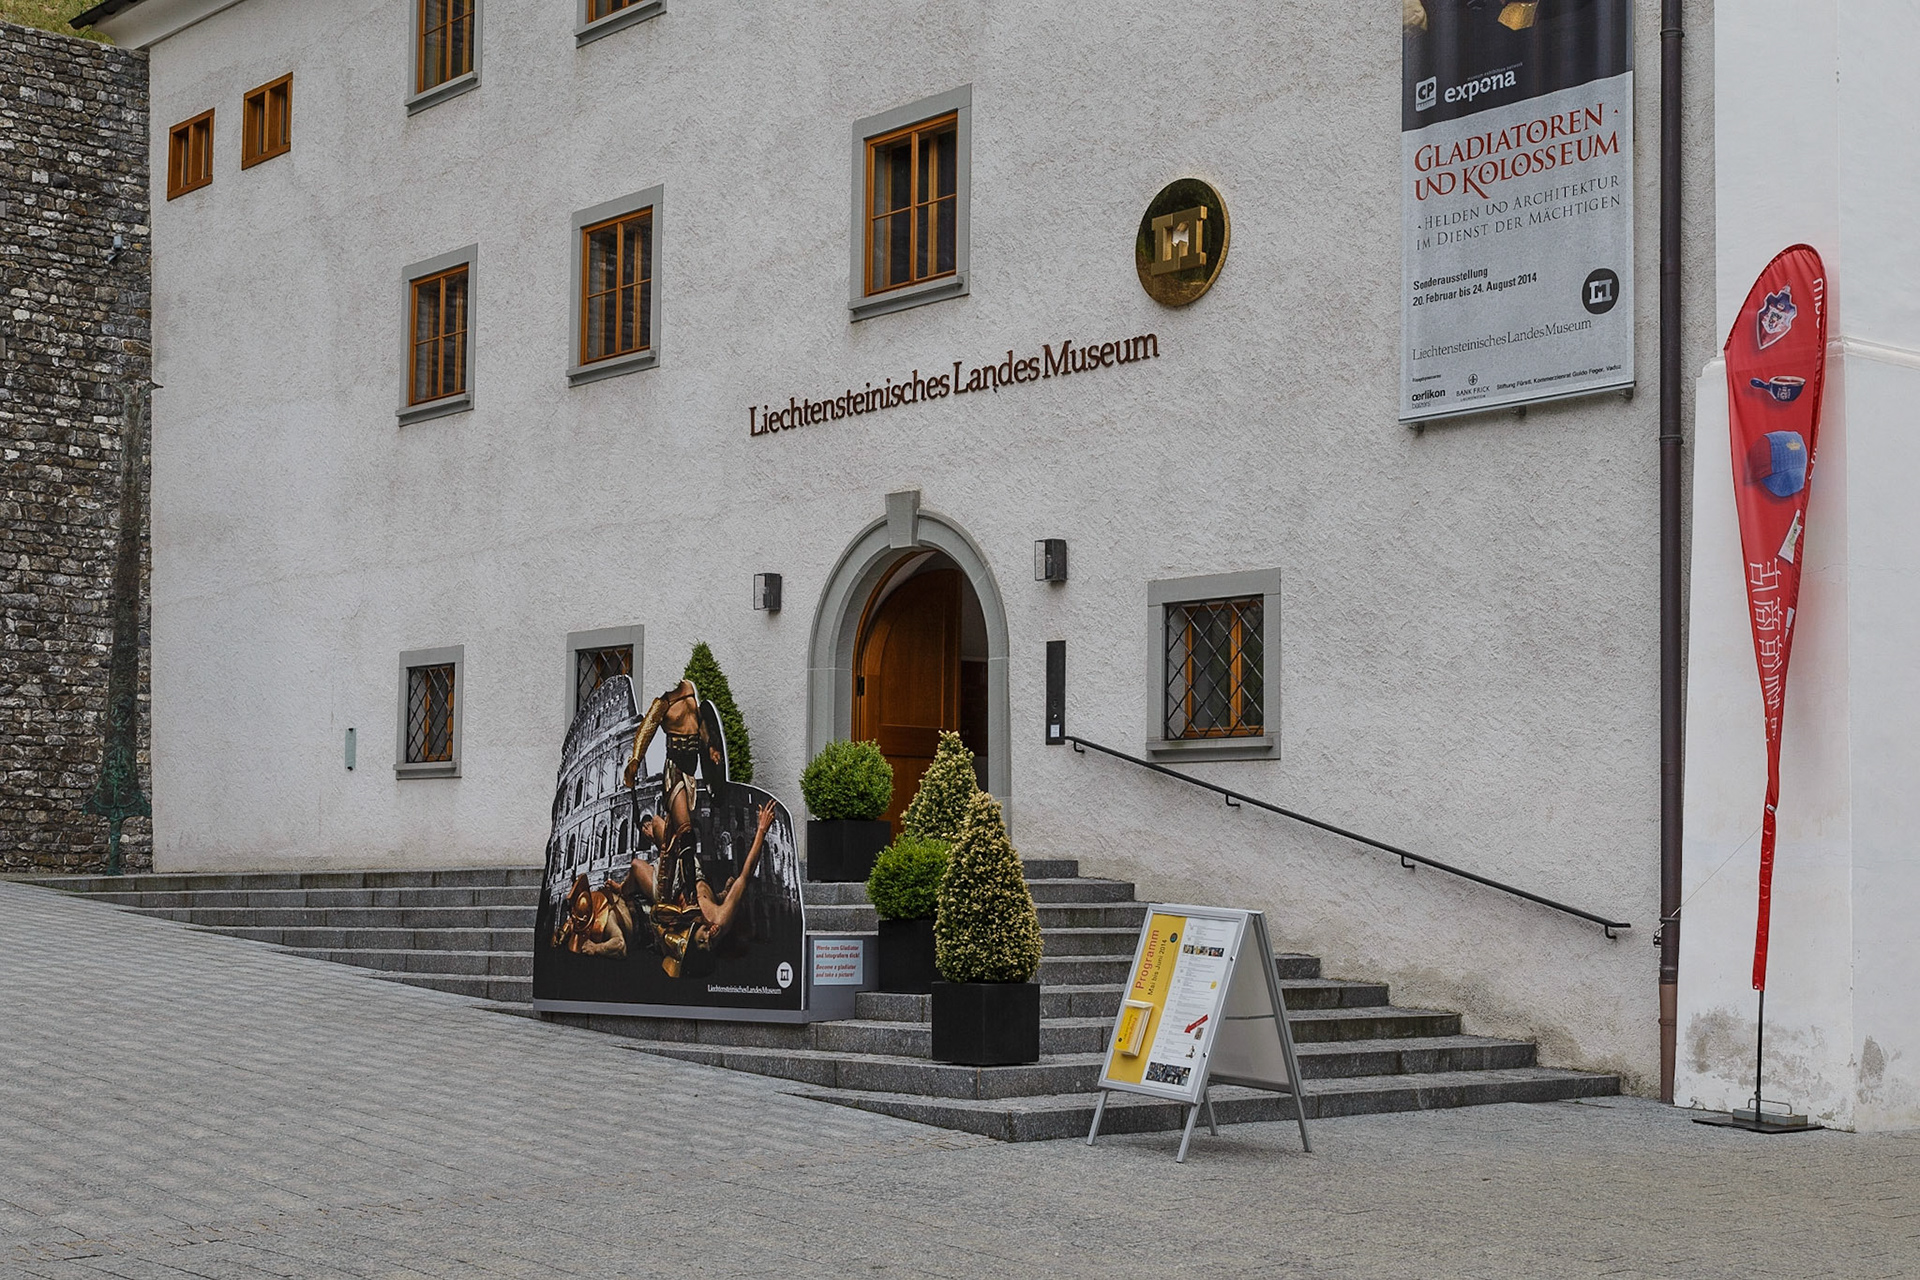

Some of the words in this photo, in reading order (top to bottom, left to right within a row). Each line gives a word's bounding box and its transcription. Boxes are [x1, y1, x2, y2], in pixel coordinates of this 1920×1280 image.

[1444, 70, 1516, 102] expona
[1415, 172, 1456, 201] UND
[1462, 130, 1621, 200] KOLOSSEUM
[1424, 205, 1480, 231] HELDEN
[1486, 200, 1508, 216] UND
[1513, 175, 1620, 209] ARCHITEKTUR
[1416, 238, 1431, 251] IM
[1437, 224, 1488, 247] DIENST
[1495, 216, 1523, 233] DER
[1528, 194, 1621, 227] MÄCHTIGEN
[1412, 267, 1488, 291] Sonderausstellung
[1412, 295, 1425, 308] 20.
[1426, 287, 1457, 304] Februar
[1458, 285, 1471, 298] bis
[1472, 282, 1485, 295] 24.
[1486, 276, 1516, 294] August
[1517, 272, 1538, 287] 2014
[1496, 382, 1516, 391] Stiftung
[1572, 370, 1588, 378] Guido
[1606, 364, 1622, 372] Vaduz
[1135, 929, 1160, 990] Programm
[1159, 938, 1168, 955] 2014
[837, 964, 856, 972] gladiator
[1156, 955, 1164, 971] Juni
[1148, 982, 1156, 996] Mai
[1152, 972, 1160, 982] bis
